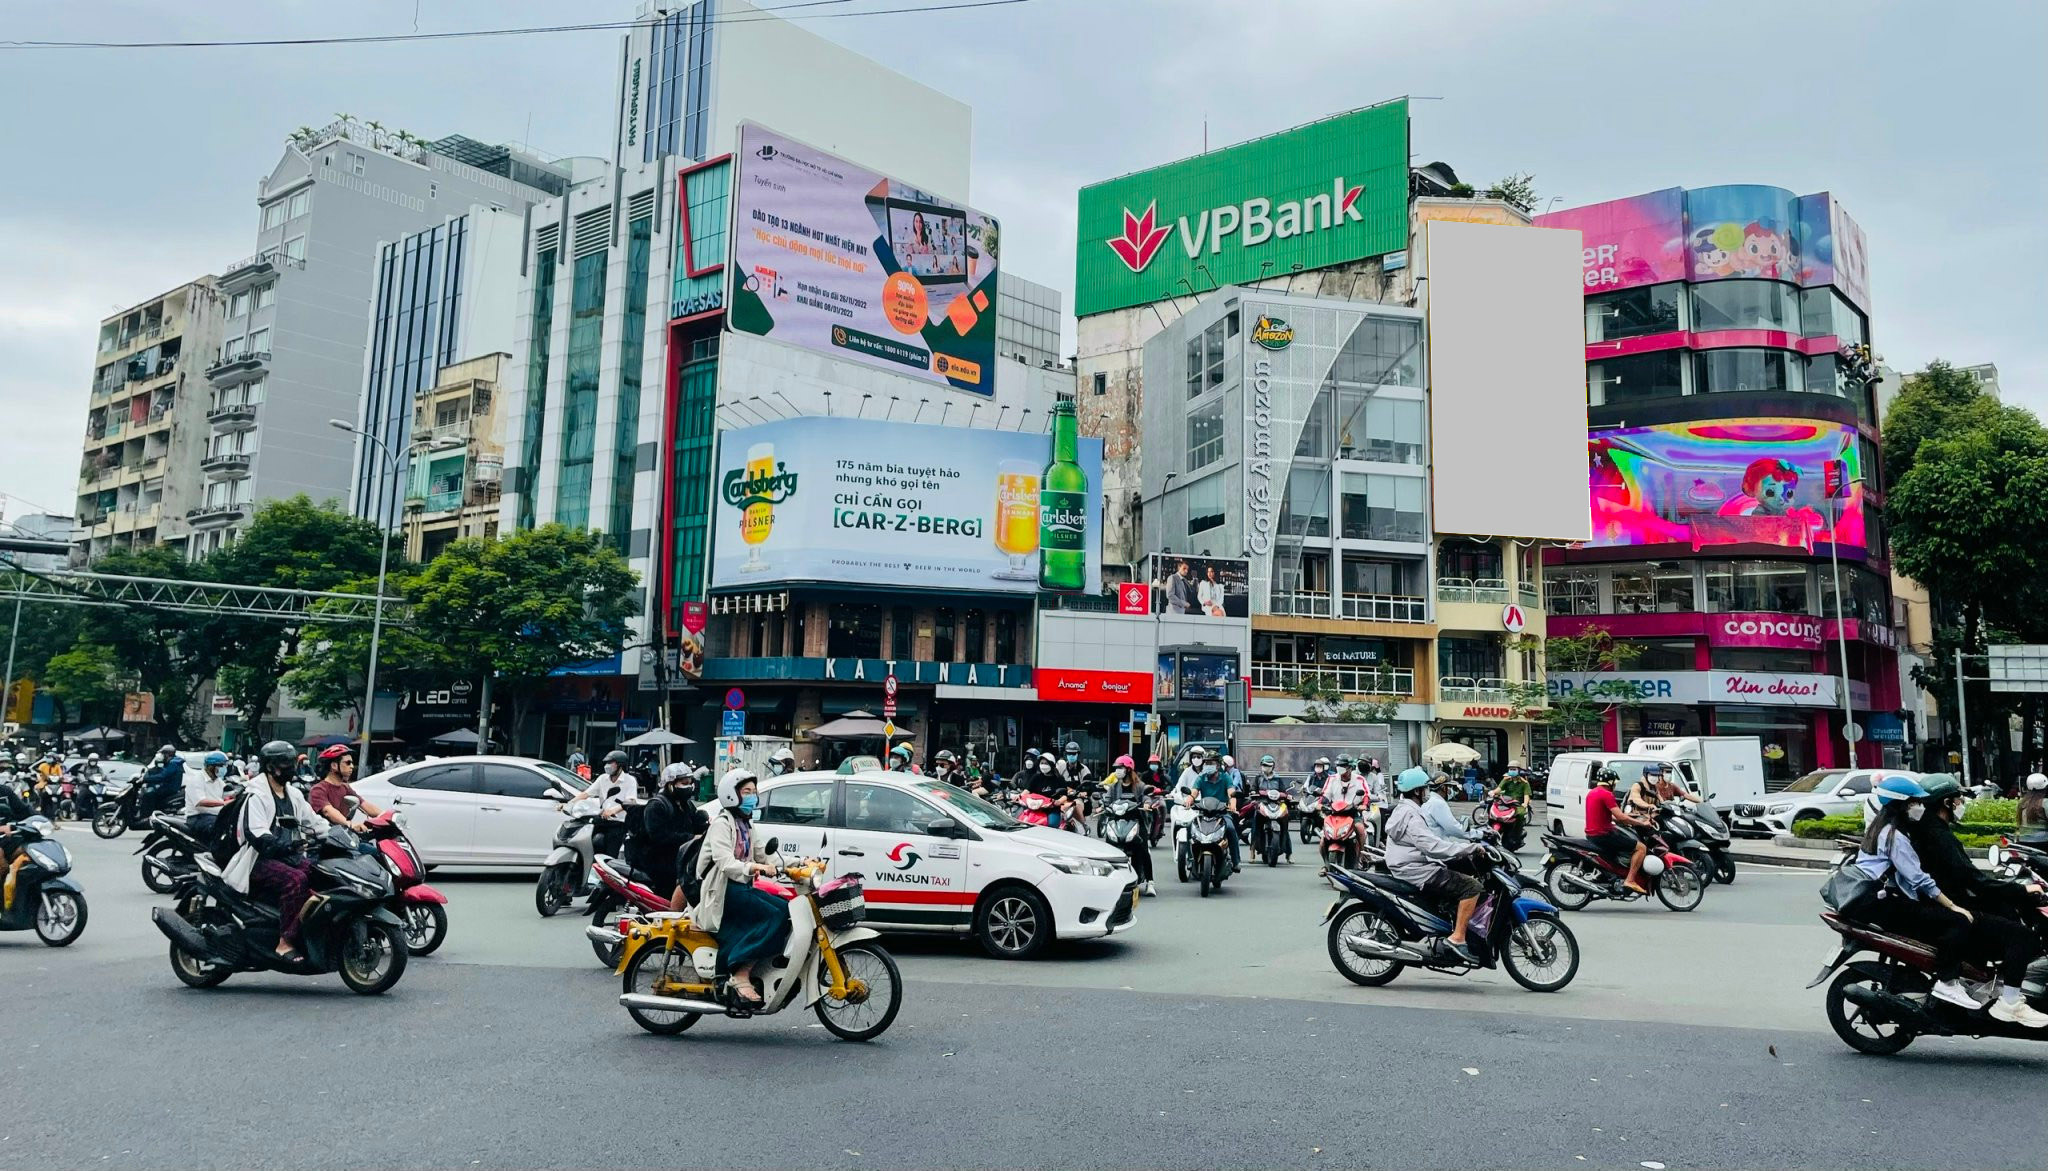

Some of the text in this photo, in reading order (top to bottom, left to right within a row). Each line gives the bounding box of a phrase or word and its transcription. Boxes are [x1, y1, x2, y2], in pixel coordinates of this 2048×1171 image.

[754, 174, 786, 192] Tuyển sinh
[1178, 177, 1365, 259] VPBank
[752, 209, 868, 256] ĐÀO TẠO 13 NGÀNH HOT NHẤT HIỆN NAY
[773, 235, 788, 248] chủ
[789, 240, 808, 256] động
[810, 247, 823, 261] mọi
[838, 256, 852, 270] mọi
[1251, 359, 1272, 480] Amazon
[836, 460, 960, 478] 175 năm bia tuyệt hảo
[722, 463, 798, 508] Carlsberg
[836, 474, 940, 490] nhưng khó gọi tên
[834, 491, 922, 512] CHỈ CẦN GỌI
[739, 514, 776, 528] PILSNER
[833, 507, 982, 538] [CAR-Z-BERG]
[1250, 487, 1272, 554] Café
[712, 593, 786, 615] KATINAT
[1332, 652, 1340, 660] of
[1342, 652, 1376, 660] NATURE
[826, 658, 1008, 684] KATINAT
[1102, 680, 1128, 692] Bonjour
[1726, 676, 1818, 696] Xin chào!
[876, 872, 950, 886] VINASUN TAXI
